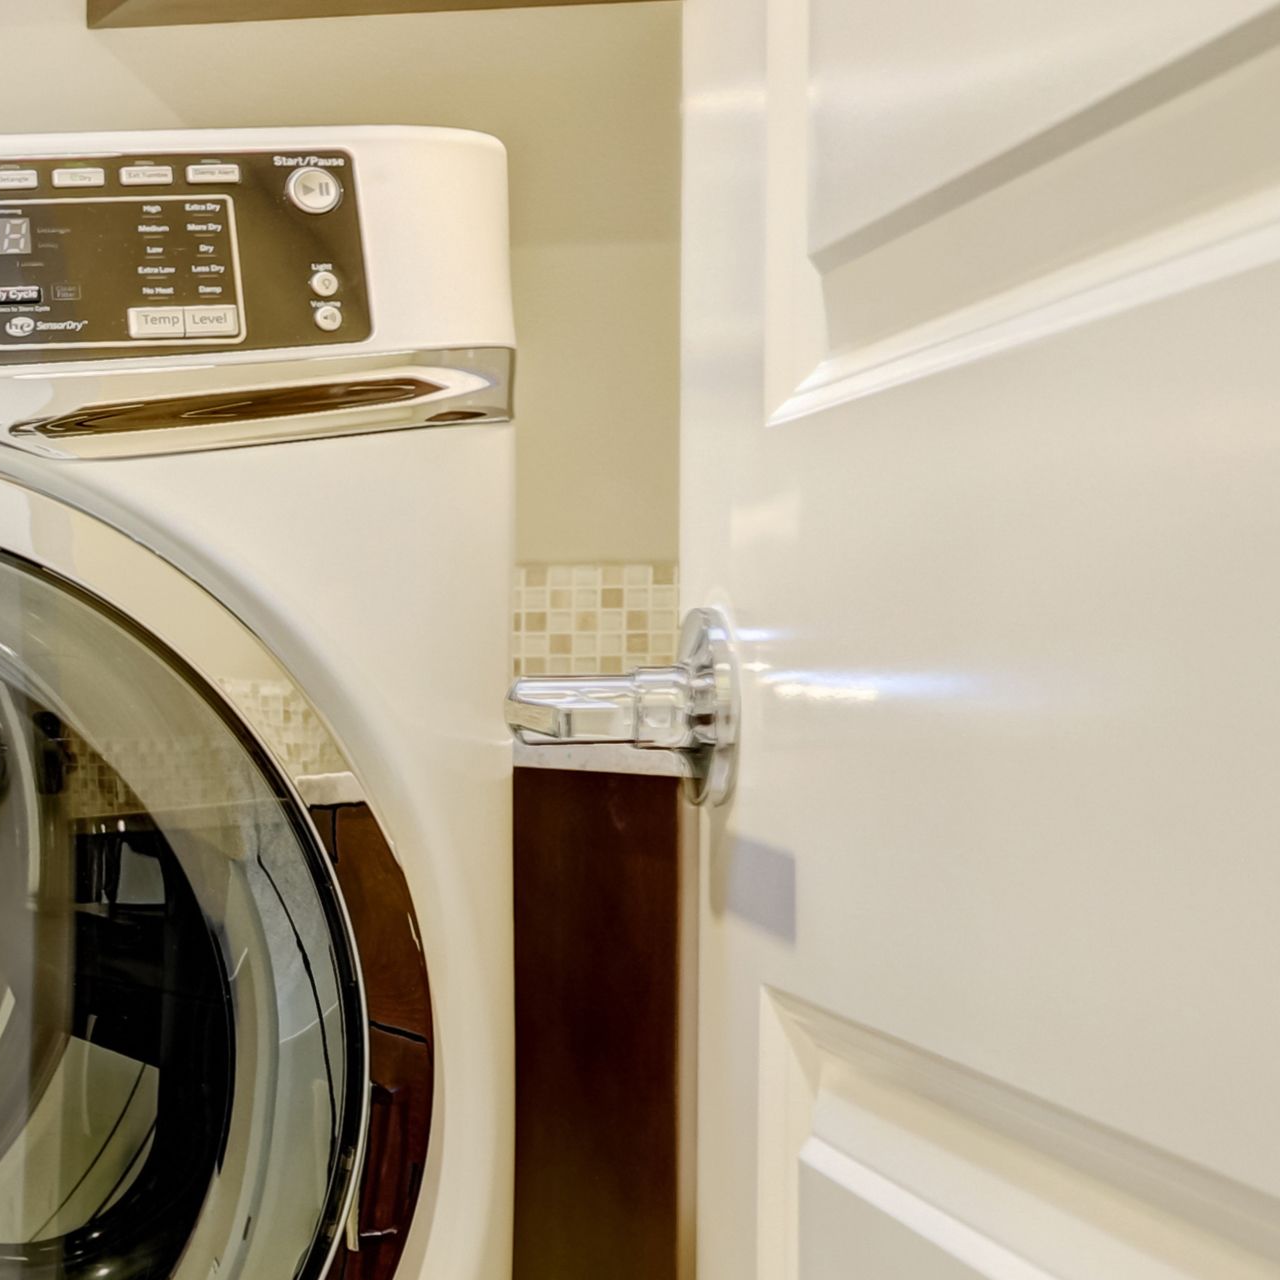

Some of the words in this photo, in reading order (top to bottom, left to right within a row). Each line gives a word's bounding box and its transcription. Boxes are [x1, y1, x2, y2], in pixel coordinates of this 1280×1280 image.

[273, 156, 344, 167] Start/Pause
[143, 205, 161, 213] High
[185, 203, 205, 211] Extra
[206, 203, 221, 212] Dry
[208, 223, 222, 232] Dry
[147, 246, 163, 254] Low
[199, 244, 214, 253] Dry
[138, 266, 158, 274] Extra
[210, 265, 225, 274] Dry
[9, 290, 38, 299] Cycle
[198, 286, 222, 294] Damp
[143, 314, 180, 327] Temp
[192, 313, 228, 325] Level
